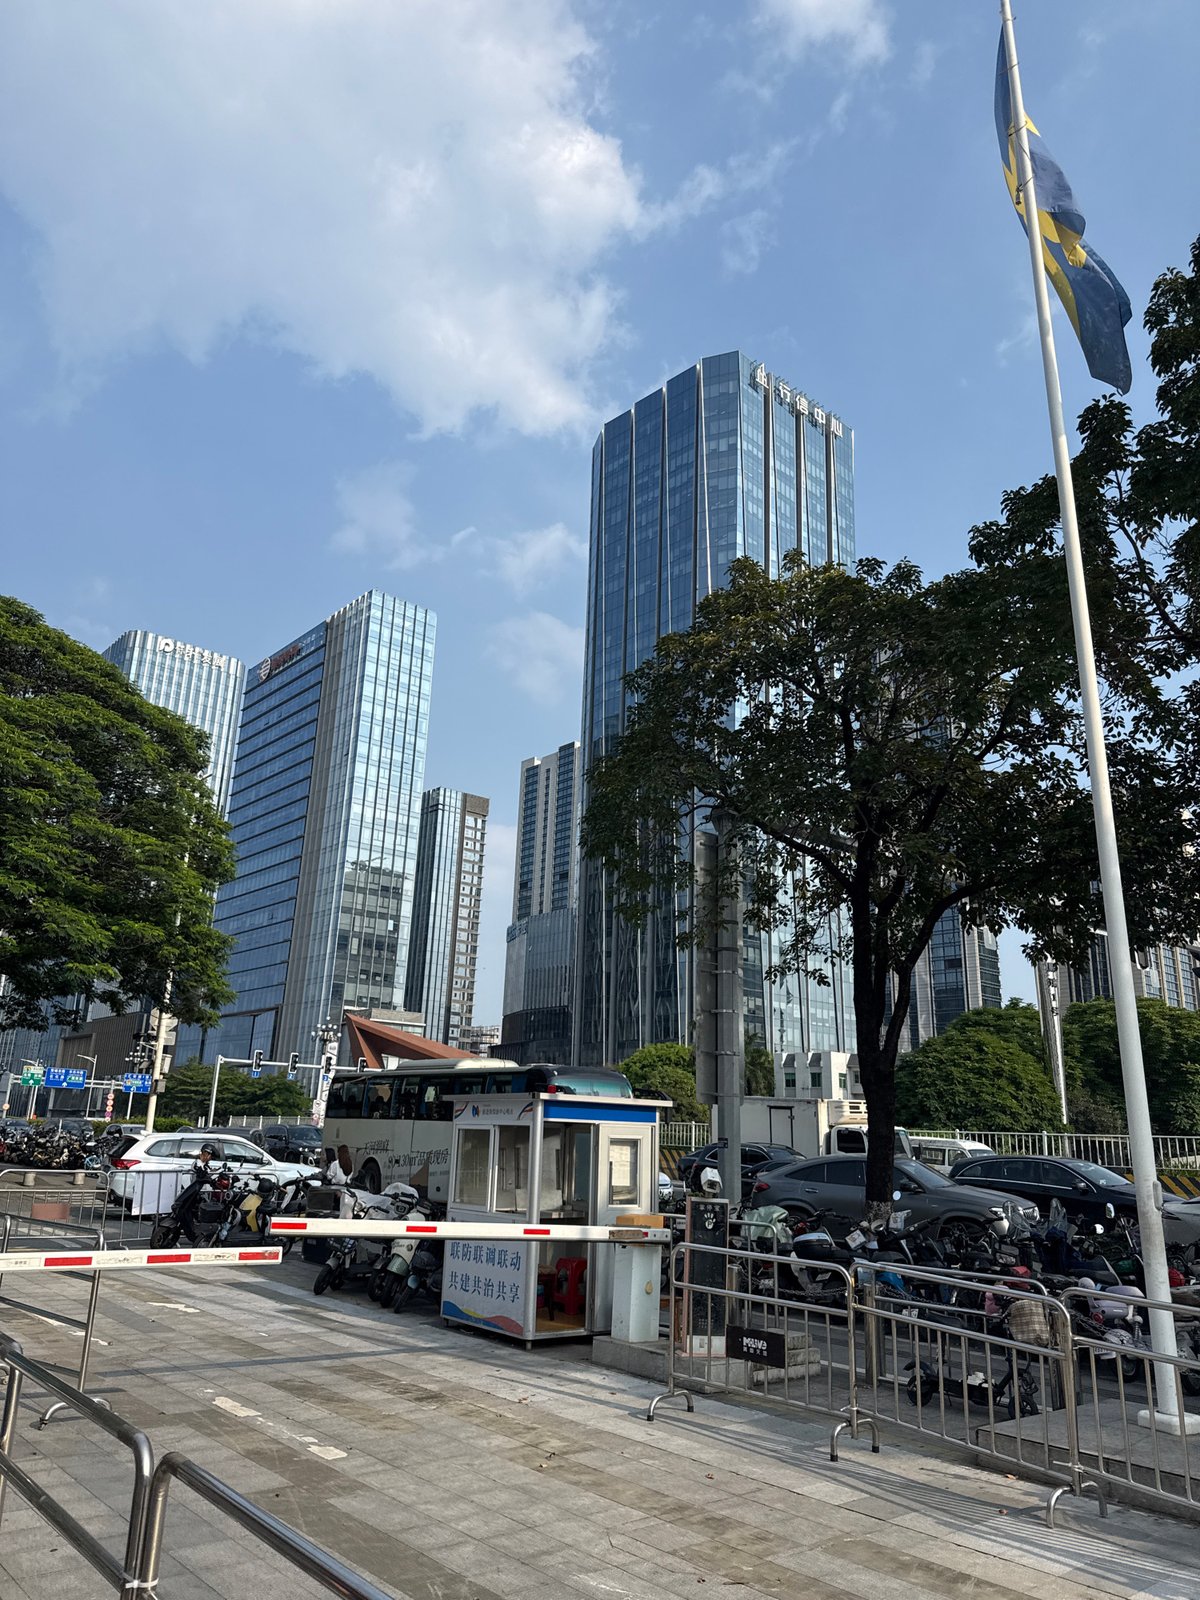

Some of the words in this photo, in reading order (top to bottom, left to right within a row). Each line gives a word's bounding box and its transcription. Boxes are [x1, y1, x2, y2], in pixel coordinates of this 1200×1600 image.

[450, 1241, 521, 1272] 联防联调联动
[448, 1271, 521, 1304] 共建共治共享
